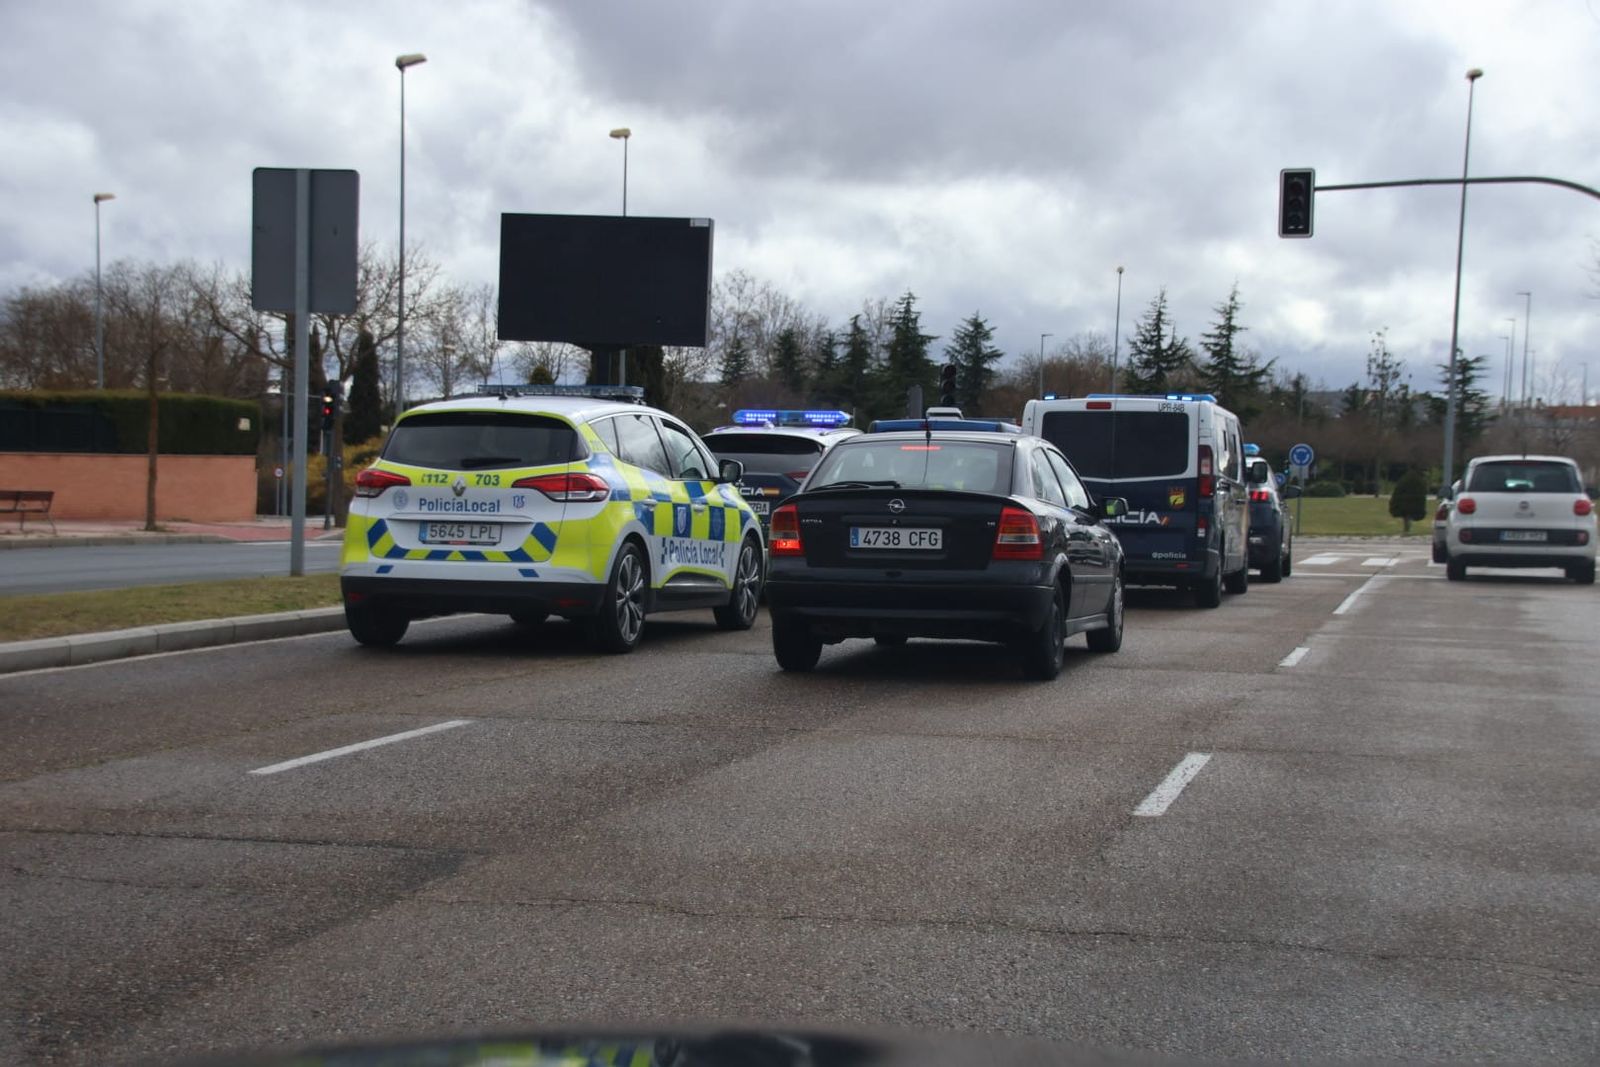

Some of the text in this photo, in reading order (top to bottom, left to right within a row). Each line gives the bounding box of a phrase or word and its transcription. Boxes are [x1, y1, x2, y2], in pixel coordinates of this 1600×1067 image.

[425, 473, 448, 484] 112
[475, 474, 501, 486] 703
[739, 486, 765, 496] CIA
[1102, 508, 1161, 524] ICÍA
[430, 524, 497, 541] 5645 LPL
[863, 530, 939, 547] 4738 CFG
[699, 542, 719, 565] Local
